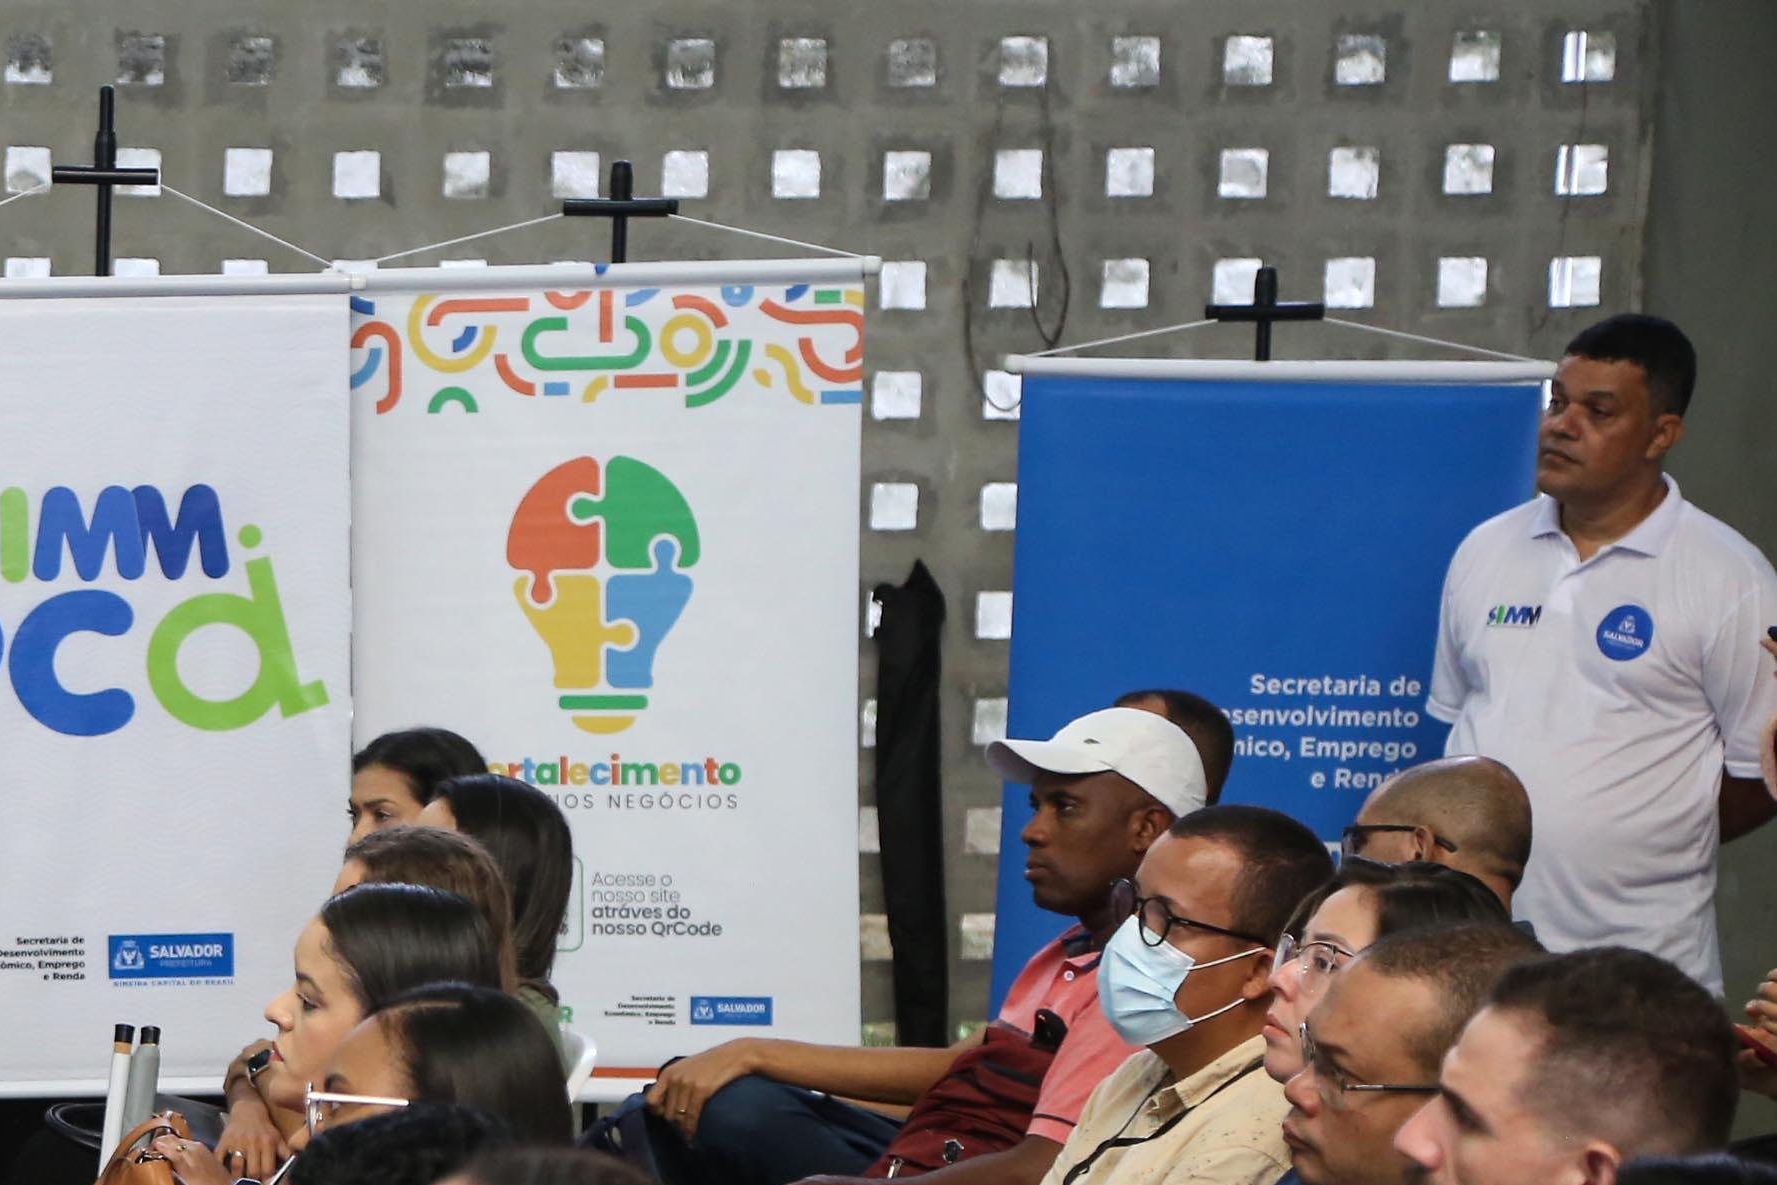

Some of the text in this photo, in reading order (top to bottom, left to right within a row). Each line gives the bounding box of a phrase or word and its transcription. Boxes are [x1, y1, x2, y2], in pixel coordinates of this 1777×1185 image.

[1487, 605, 1543, 625] SIMM
[1250, 674, 1422, 697] Secretaria de
[1221, 705, 1420, 728] senvolvimento
[1300, 736, 1417, 762] Emprego
[1310, 771, 1326, 789] e
[608, 791, 738, 809] NEGÓCIOS
[592, 872, 672, 887] Acesse o
[592, 888, 681, 903] nosso site
[592, 903, 691, 919] atráves do
[592, 921, 723, 937] nosso QrCode
[16, 936, 85, 945] Secretaria de
[150, 943, 223, 958] SALVADOR
[38, 960, 86, 971] Emprego
[53, 972, 86, 981] Renda
[717, 1003, 766, 1014] SALVADOR
